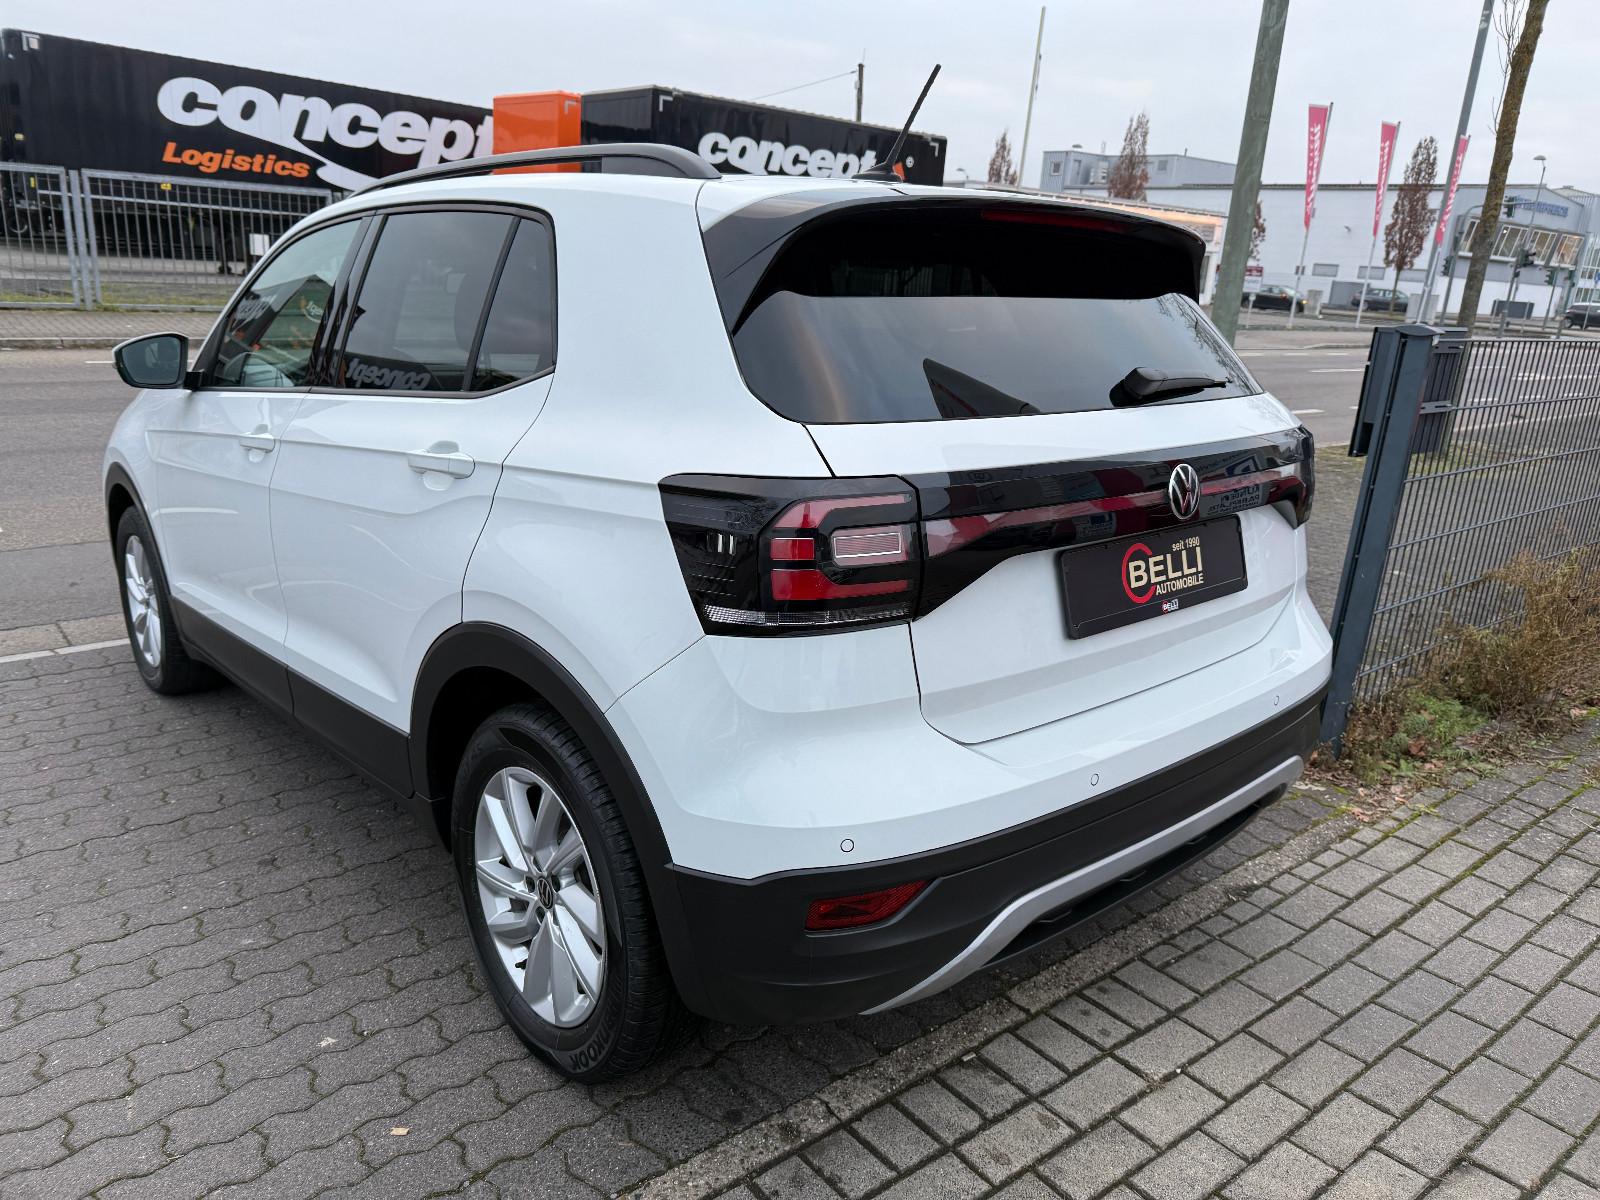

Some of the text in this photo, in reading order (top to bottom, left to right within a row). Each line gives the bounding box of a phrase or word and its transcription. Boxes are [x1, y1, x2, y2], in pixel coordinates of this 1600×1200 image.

[157, 76, 494, 170] concept
[162, 142, 310, 179] Logistics
[698, 132, 877, 178] concept
[1172, 536, 1200, 551] seit 1990
[1128, 547, 1203, 589] BELLI
[1156, 573, 1204, 596] AUTOMOBILE
